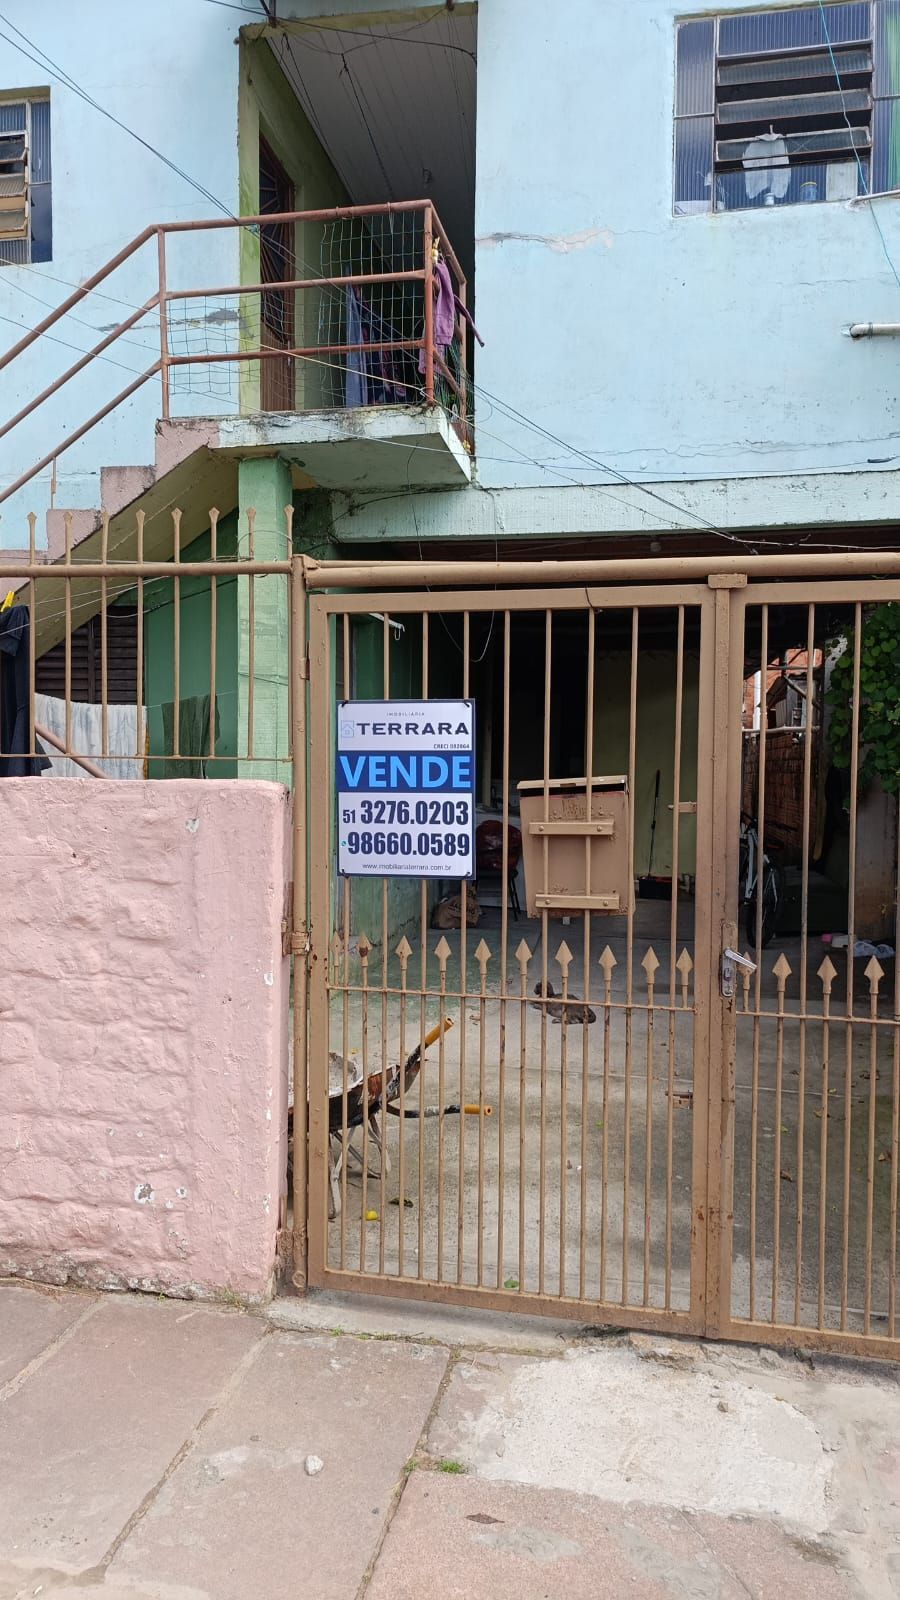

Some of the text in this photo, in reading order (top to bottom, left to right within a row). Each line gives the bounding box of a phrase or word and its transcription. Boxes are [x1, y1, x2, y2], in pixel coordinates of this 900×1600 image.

[357, 722, 469, 735] TERRARA
[339, 755, 471, 788] VENDE
[342, 800, 469, 825] 51 3276.0203
[347, 831, 470, 856] 98660.0589
